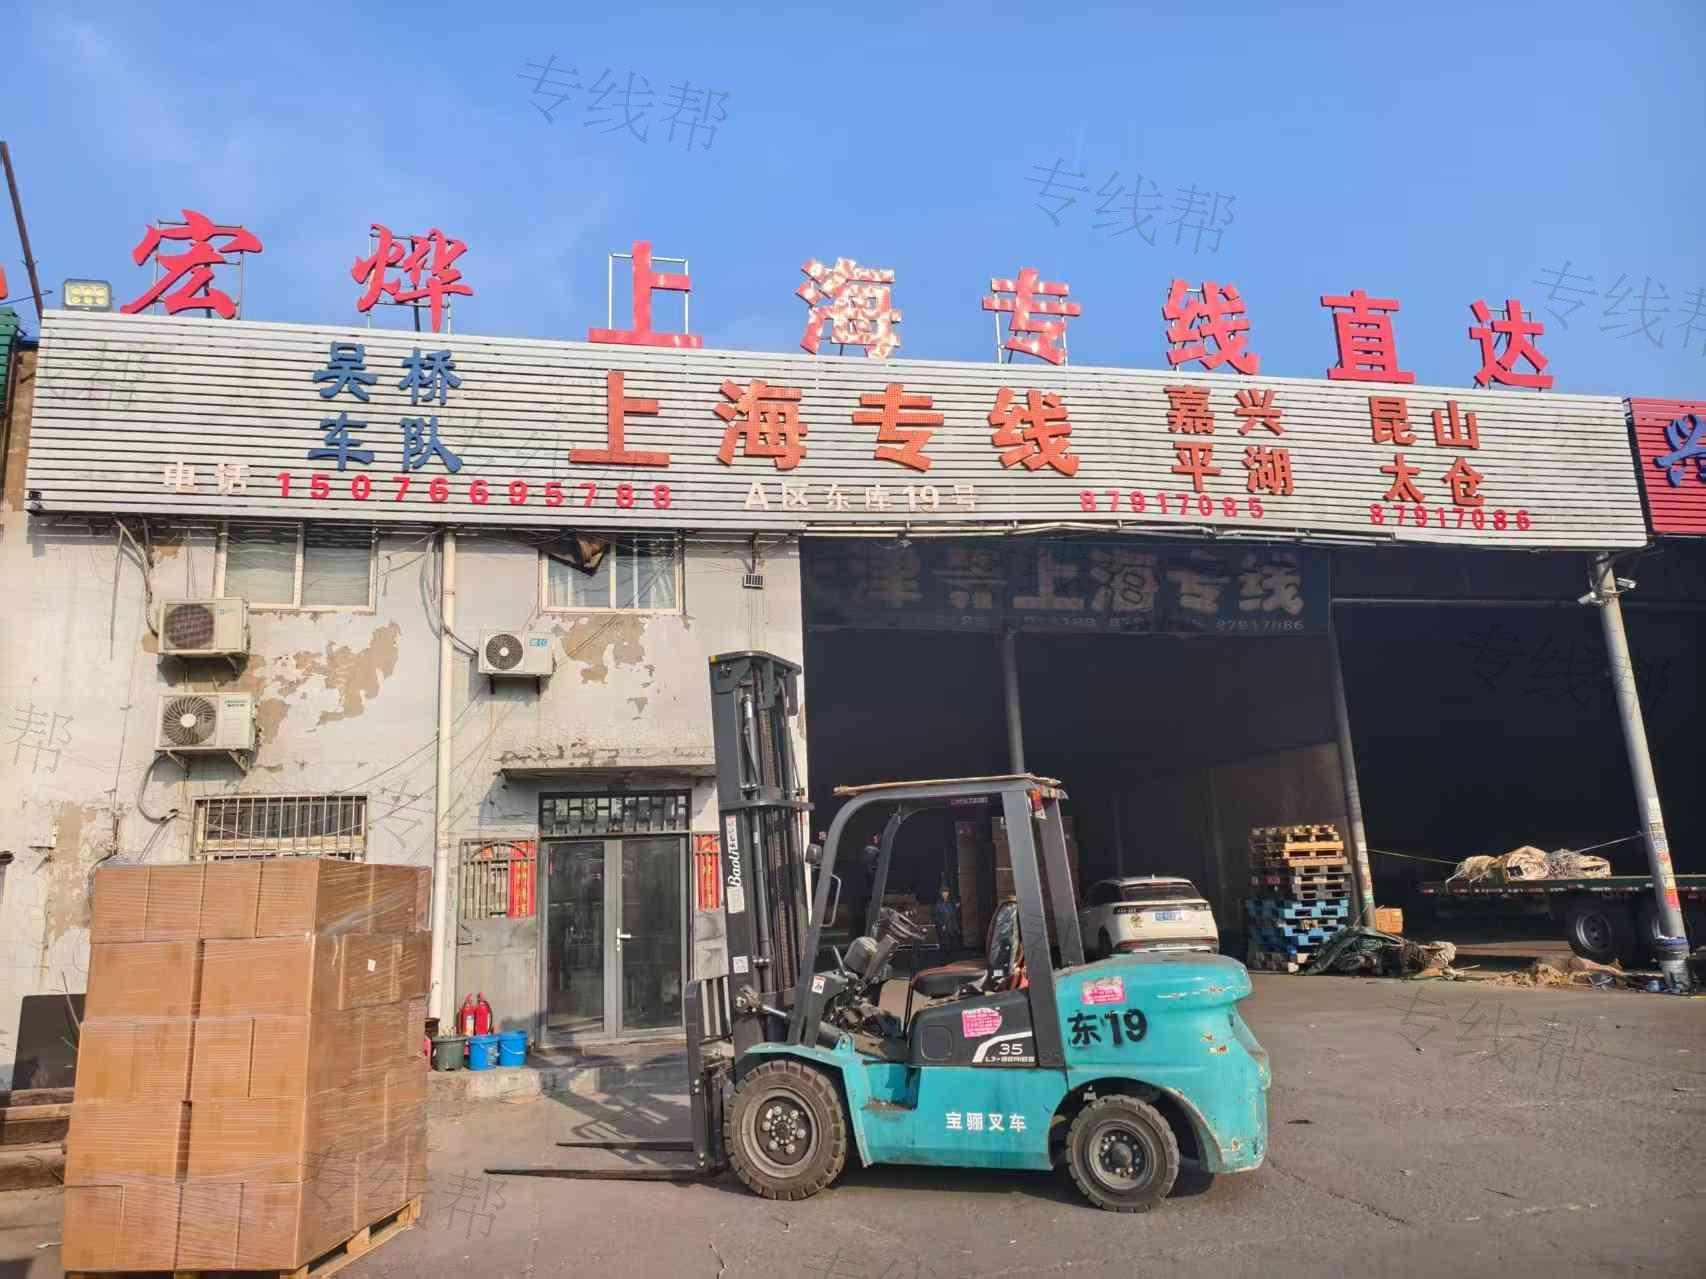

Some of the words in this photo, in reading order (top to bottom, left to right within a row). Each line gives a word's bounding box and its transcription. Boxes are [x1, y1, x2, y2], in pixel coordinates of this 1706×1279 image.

[312, 341, 461, 406] 吴桥
[568, 370, 1081, 477] 上海专线
[1164, 384, 1285, 436] 嘉兴
[1367, 395, 1481, 450] 昆山
[307, 410, 463, 474] 车队
[276, 472, 673, 510] 15076695788
[1171, 441, 1294, 496] 平湖
[1382, 453, 1485, 507] 太仓
[1080, 488, 1265, 521] 87917085
[1369, 503, 1532, 532] 87917086
[727, 847, 741, 887] Baoli
[1067, 1009, 1147, 1045] 东19
[998, 1043, 1023, 1055] 35
